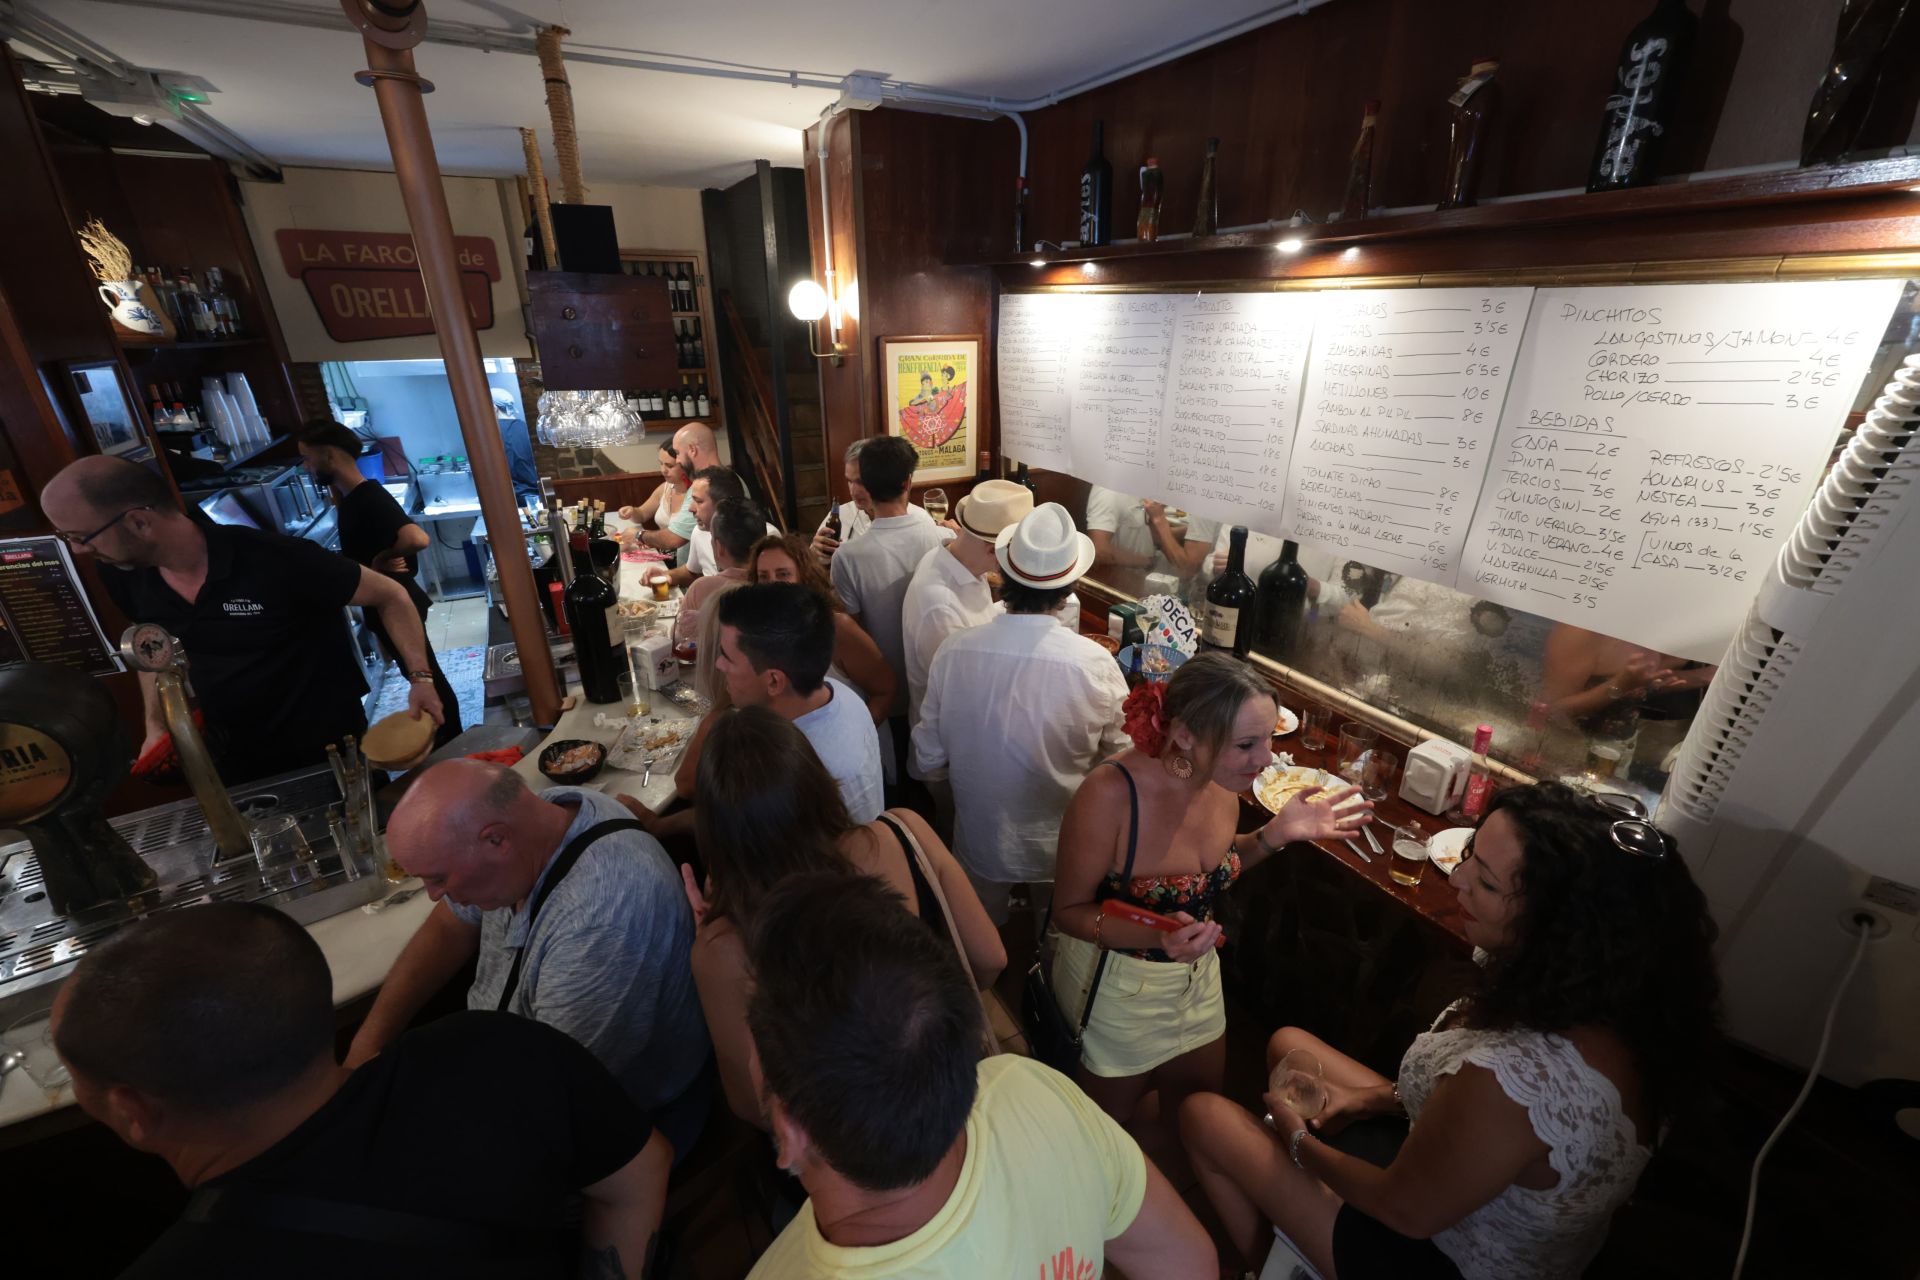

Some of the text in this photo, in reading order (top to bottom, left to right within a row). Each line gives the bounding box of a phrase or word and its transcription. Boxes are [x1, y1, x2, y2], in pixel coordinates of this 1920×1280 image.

[298, 243, 485, 266] LA FARO de
[1481, 299, 1507, 314] 3€
[1560, 303, 1662, 326] PINCHITOS
[1474, 319, 1510, 335] 3'5€
[1466, 342, 1491, 357] 4€
[1588, 350, 1841, 368] CORDERO 4€
[1465, 362, 1501, 377] 6'5€
[1586, 370, 1841, 388] CHORIZO 2'5€
[1461, 387, 1490, 401] 10€
[1785, 395, 1820, 411] 3€
[1461, 408, 1484, 424] 8€
[1528, 409, 1614, 433] BEBIDAS
[1456, 436, 1478, 450] 3€
[1595, 442, 1621, 458] 2€
[1452, 456, 1471, 470] 3€
[1507, 451, 1613, 481] PINTA 4€
[1649, 449, 1802, 485] REFRESCOS 2'5€
[1501, 469, 1616, 500] TERCIOS 3€
[1752, 483, 1782, 500] 3€
[1440, 486, 1461, 502] 8€
[1435, 503, 1454, 516] 7€
[1636, 489, 1776, 518] NESTEA 3€
[1495, 506, 1531, 525] TINTO
[1534, 514, 1586, 536] VERANO
[1598, 504, 1622, 522] 2€
[1640, 511, 1681, 529] AGUA
[1434, 521, 1452, 536] 8€
[1428, 539, 1446, 556] 6€
[1501, 543, 1539, 561] DULCE
[1600, 546, 1625, 562] 4€
[1648, 531, 1694, 555] VINOS
[1697, 544, 1725, 560] de
[1640, 551, 1680, 570] CASA
[1162, 598, 1195, 643] DECA
